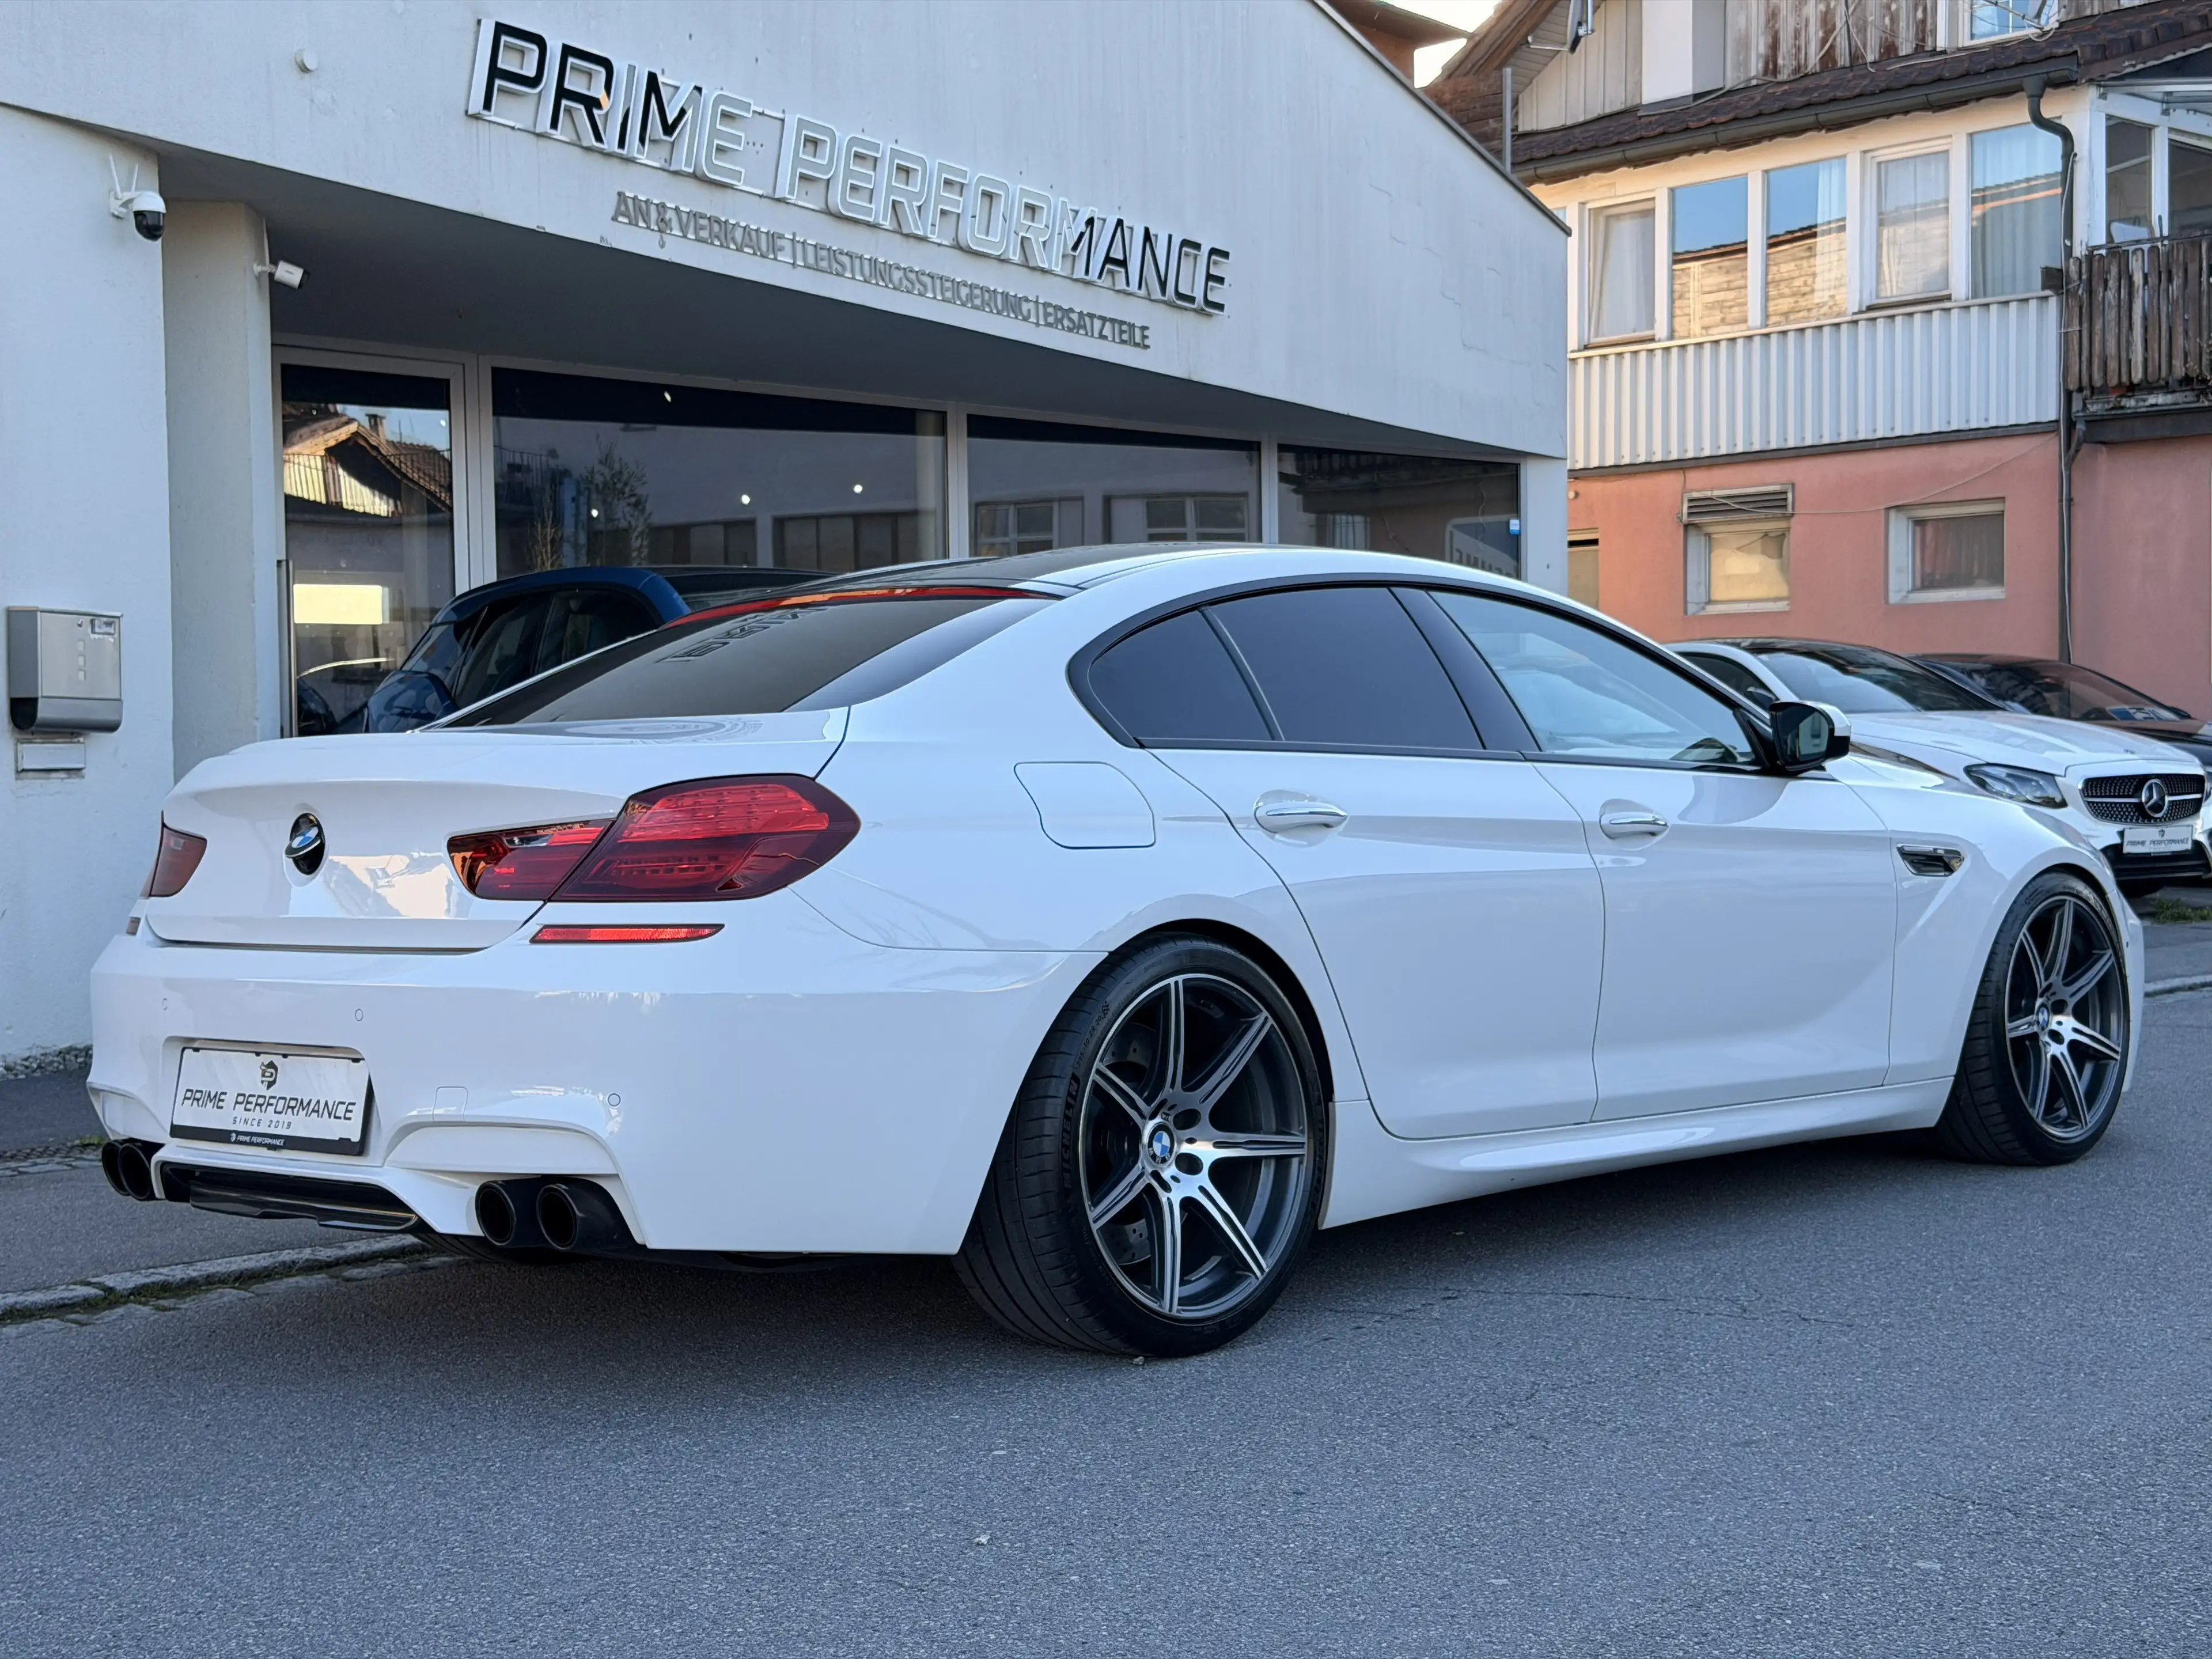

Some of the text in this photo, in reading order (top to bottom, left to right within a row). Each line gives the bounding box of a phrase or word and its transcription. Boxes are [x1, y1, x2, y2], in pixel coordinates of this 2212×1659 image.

[468, 19, 1231, 316] PRIME PERFORMANCE
[181, 1089, 356, 1121] PRIME PERFORMANCE
[232, 1116, 262, 1127] SINCE
[1062, 1079, 1079, 1188] MICHELIN
[251, 1137, 285, 1146] PERFORMANCE
